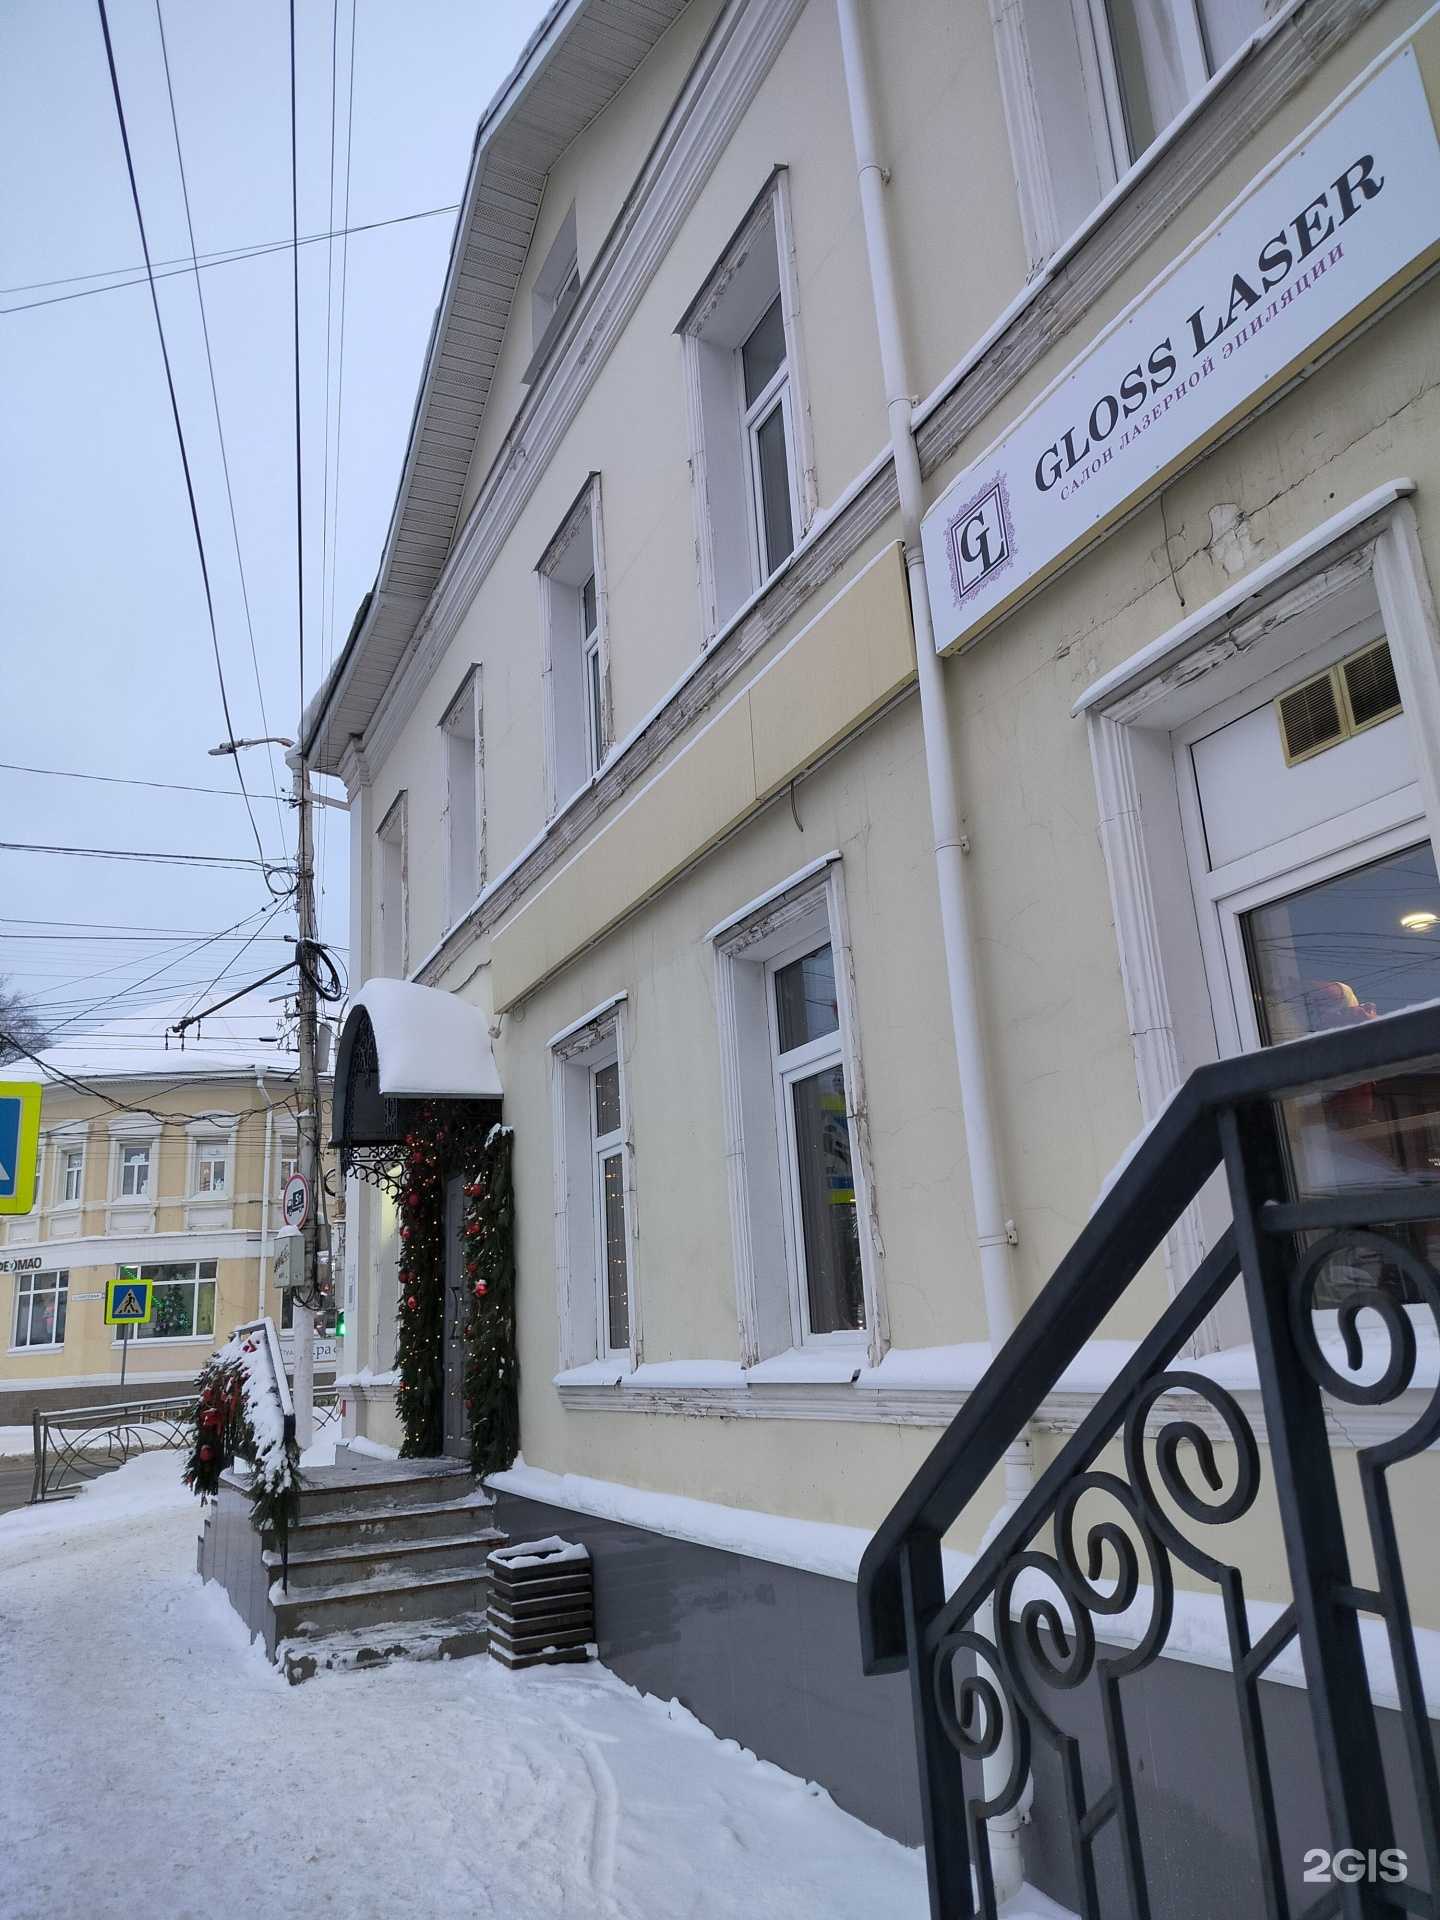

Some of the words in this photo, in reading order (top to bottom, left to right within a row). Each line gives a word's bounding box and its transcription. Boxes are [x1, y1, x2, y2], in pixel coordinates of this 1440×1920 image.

[1035, 337, 1176, 491] GLOSS
[1186, 155, 1384, 358] LASER
[1060, 447, 1113, 500] САЛОН
[1120, 356, 1215, 450] ЛАЗЕРНОЙ
[1222, 242, 1344, 360] ЭПИЛЯЦИИ
